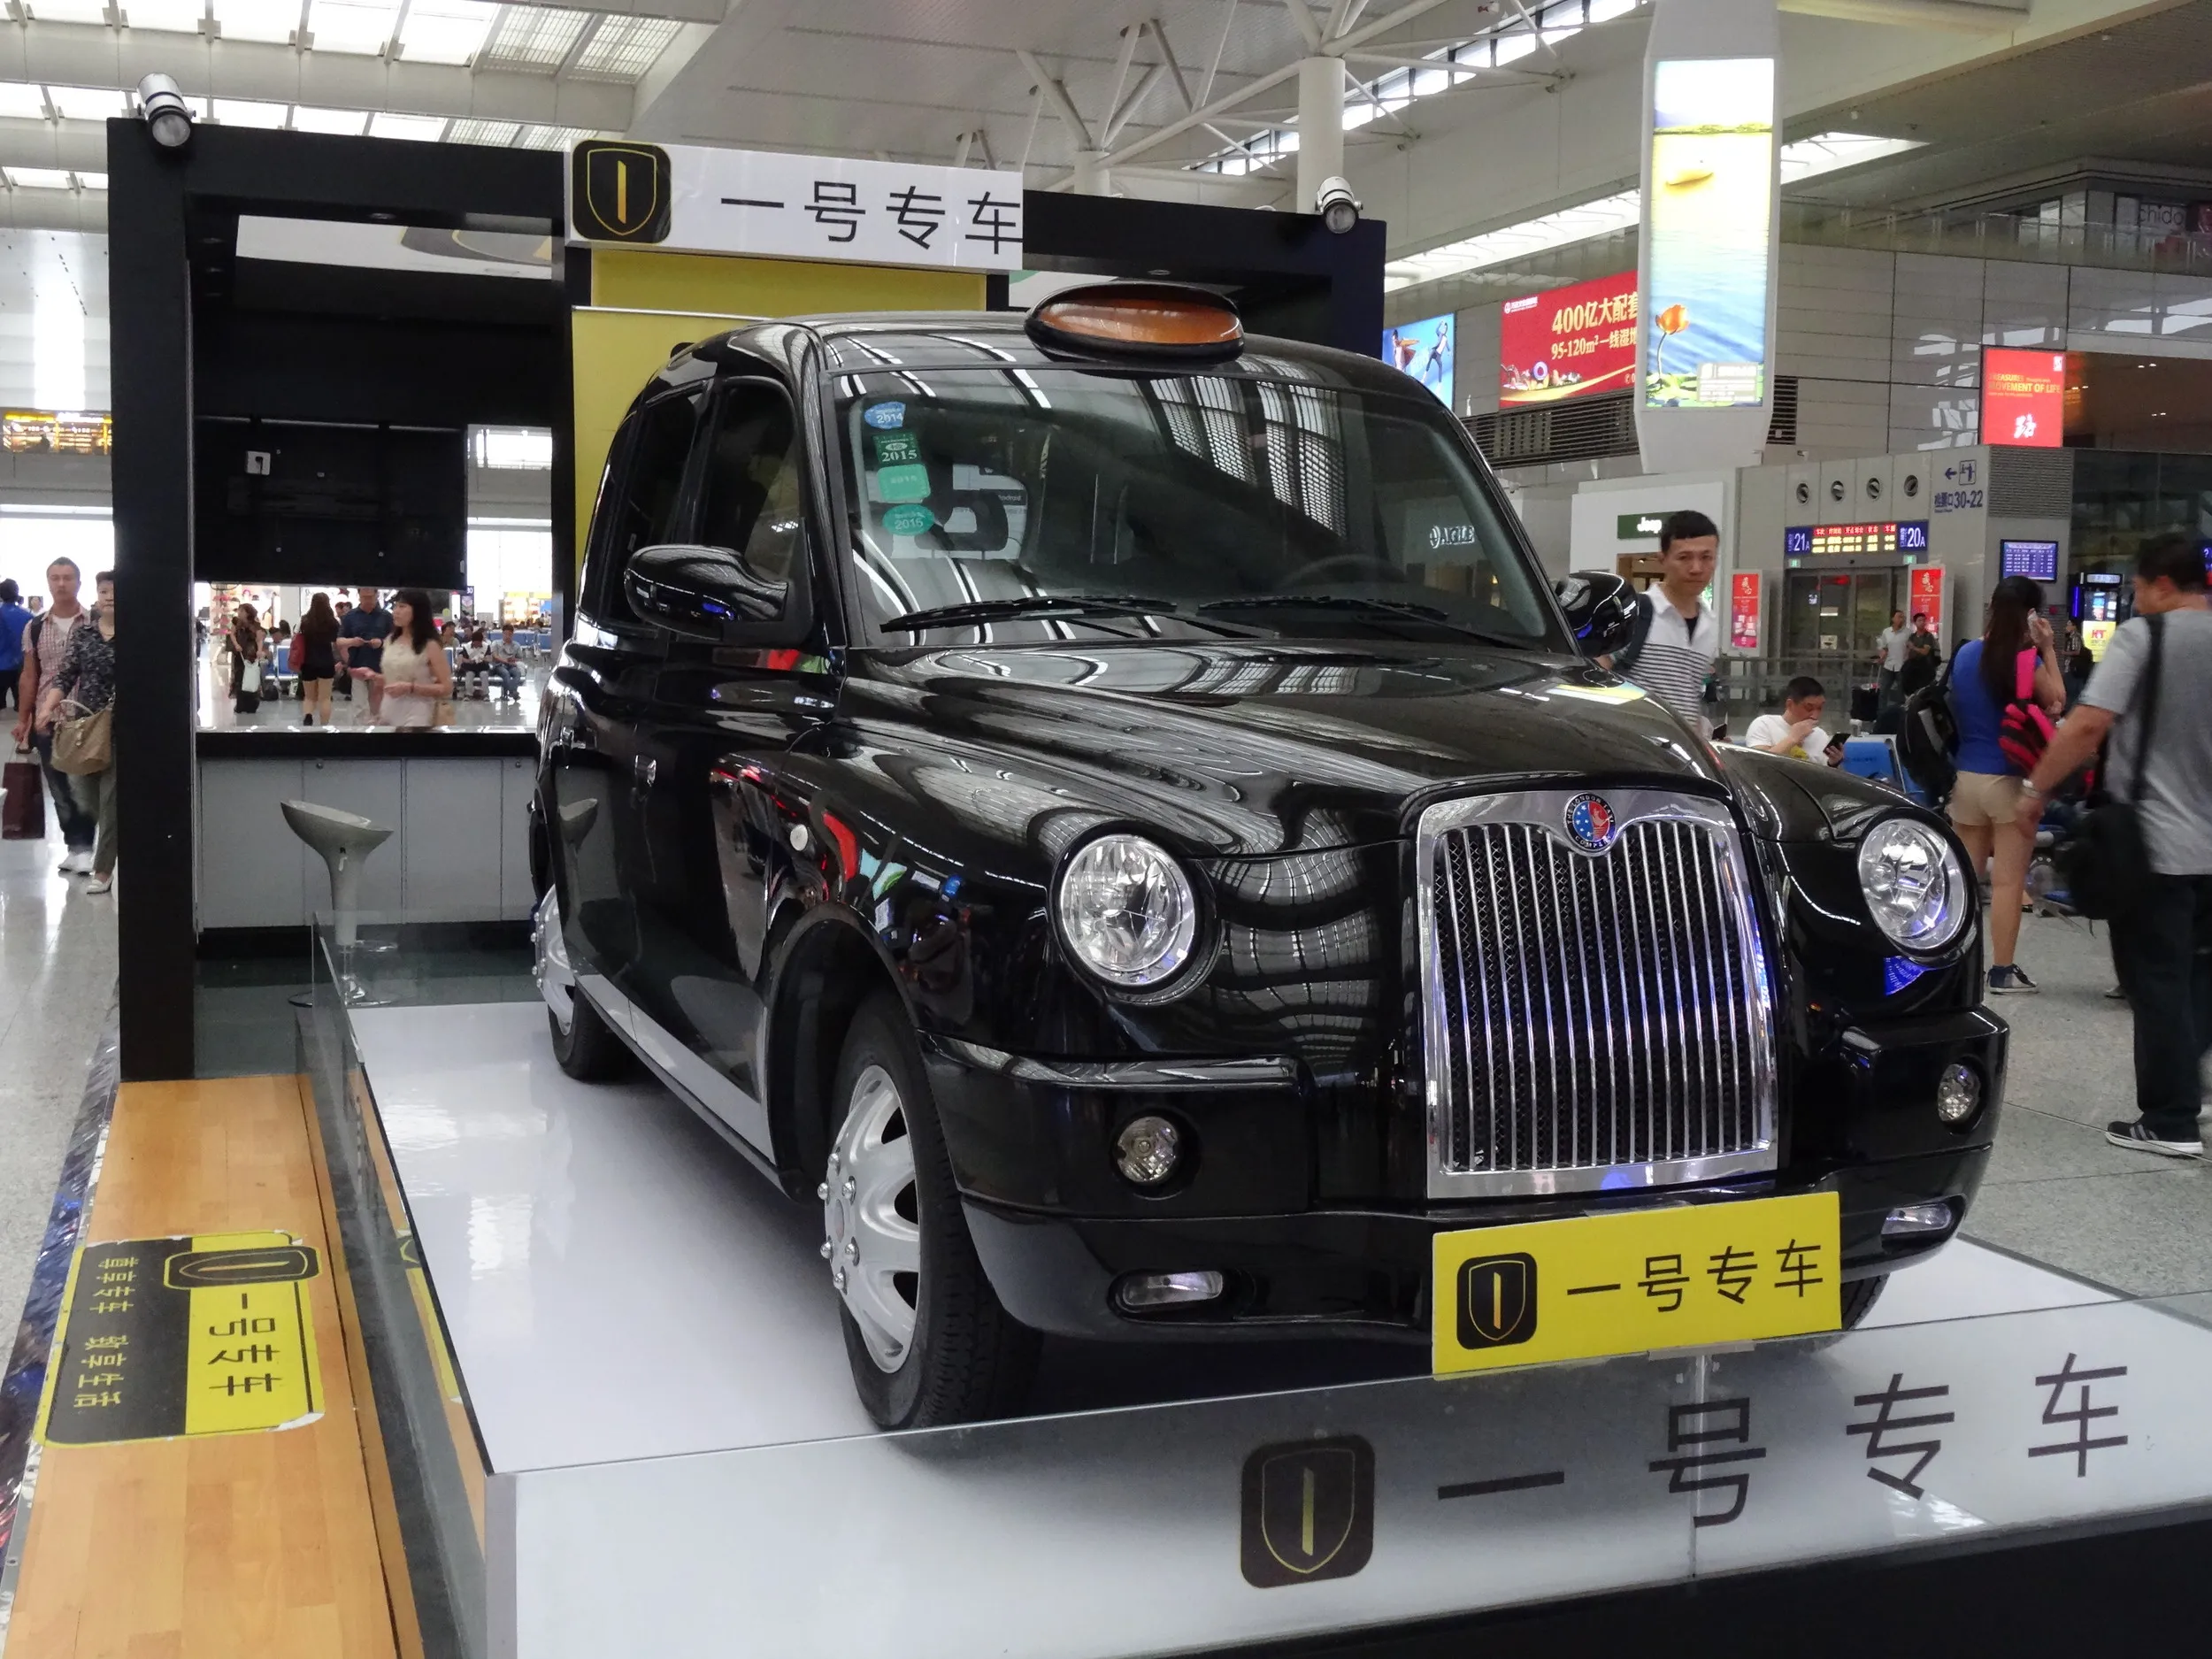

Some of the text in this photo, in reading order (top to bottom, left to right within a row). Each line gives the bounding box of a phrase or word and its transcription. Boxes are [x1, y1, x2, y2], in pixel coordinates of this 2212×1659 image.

[721, 181, 1023, 255] 一号专车
[876, 411, 903, 424] 2014
[2034, 384, 2045, 393] OF
[2046, 384, 2060, 394] LIFE
[881, 449, 918, 463] 2015
[1571, 795, 1601, 807] LONDON
[1603, 804, 1615, 823] TAXI
[1567, 1239, 1824, 1313] 一号专车
[73, 1256, 139, 1409] 尊享专车 致享生活
[208, 1293, 282, 1396] 一号专车
[1438, 1353, 2129, 1527] 一号专车
